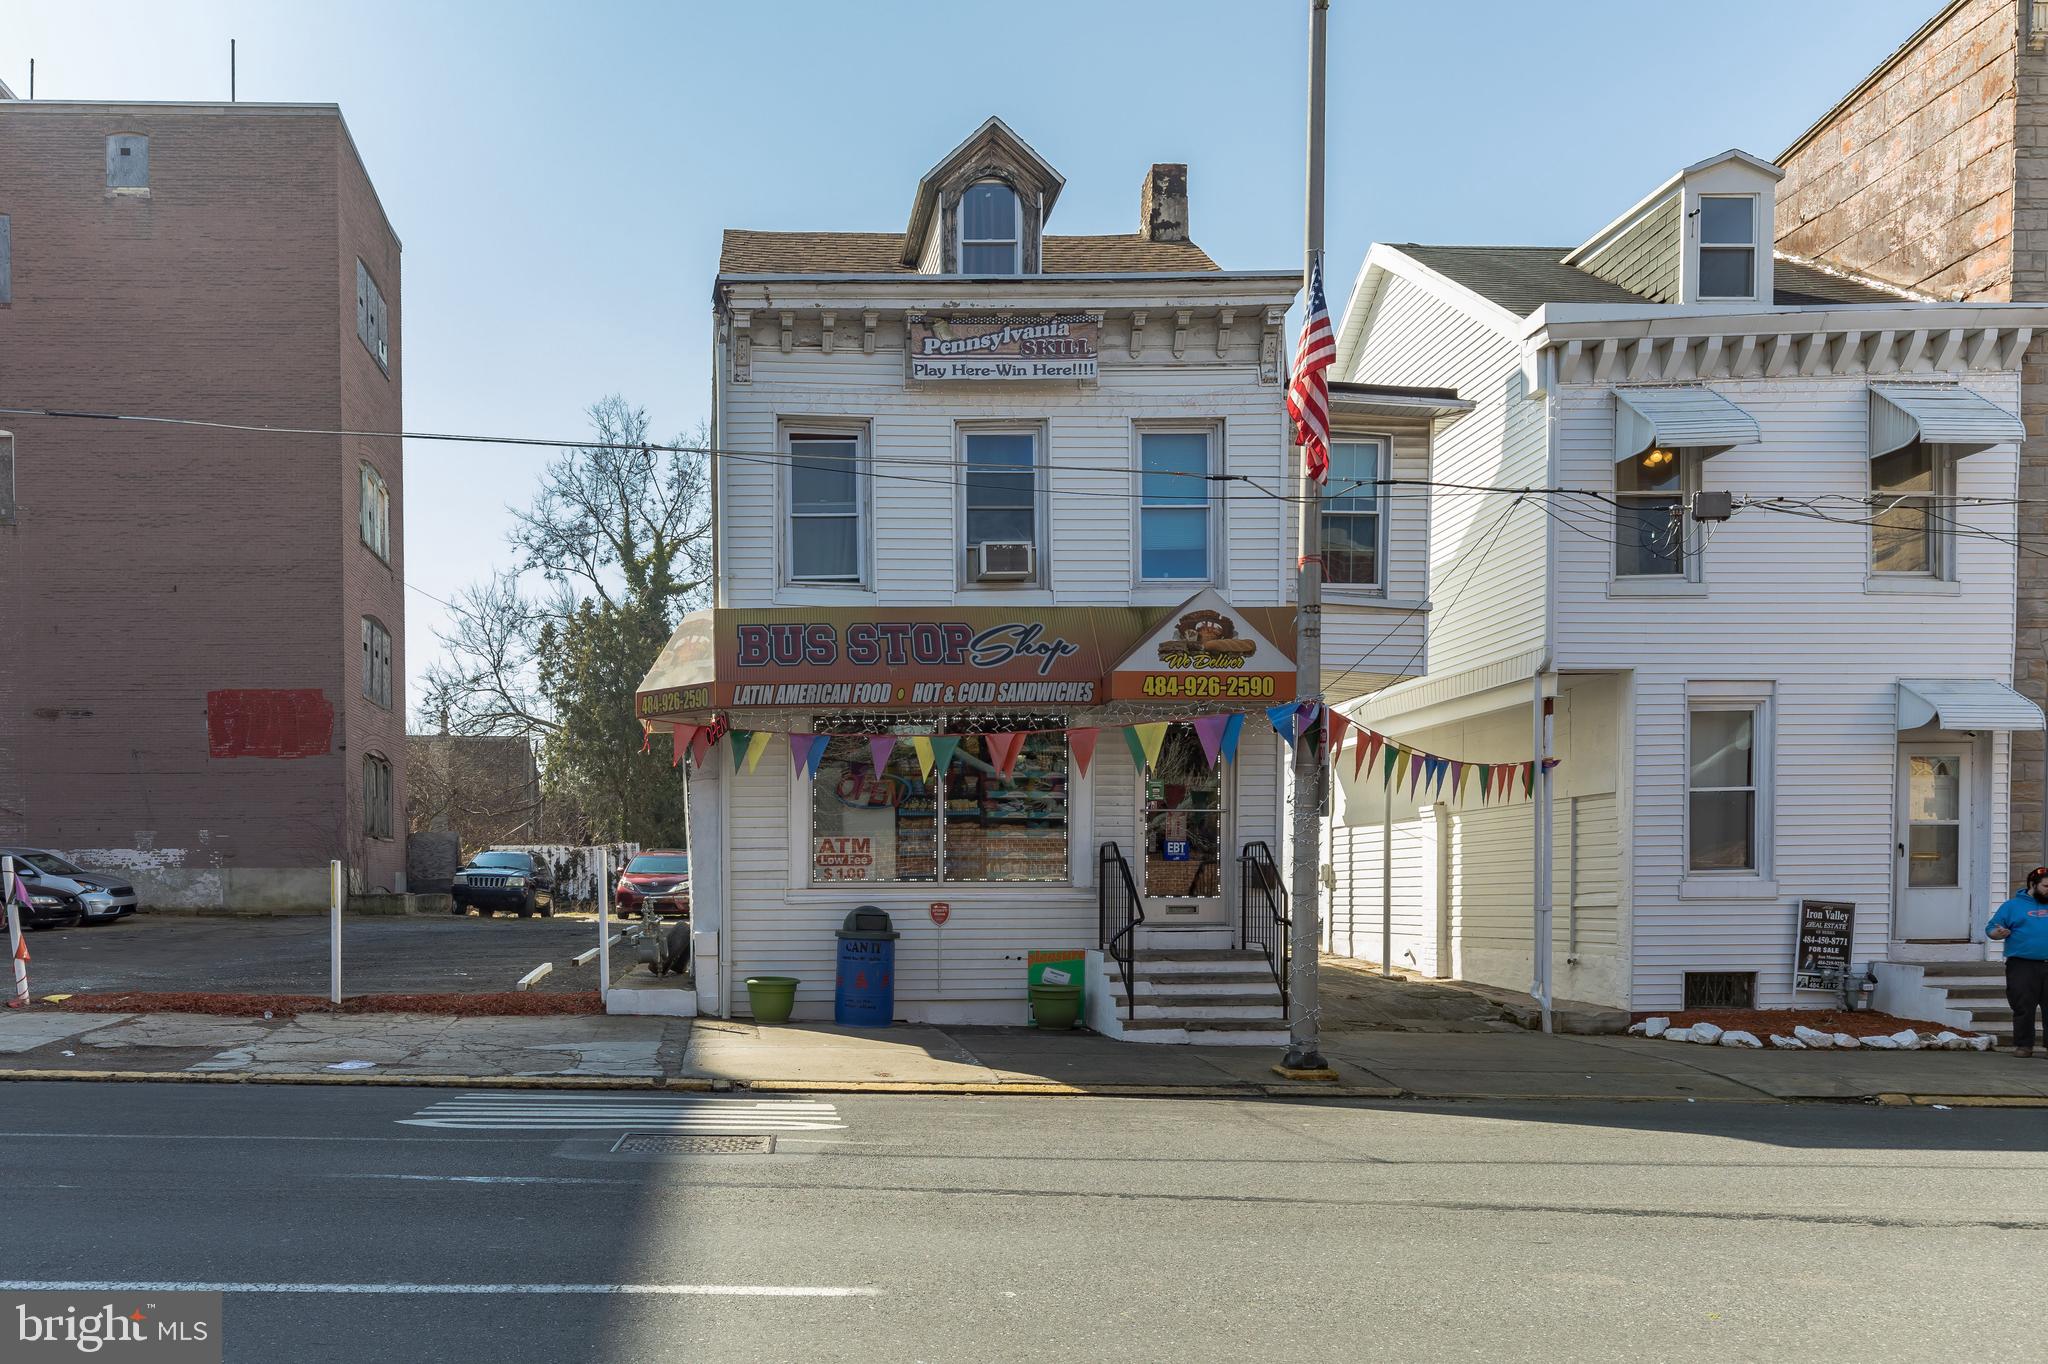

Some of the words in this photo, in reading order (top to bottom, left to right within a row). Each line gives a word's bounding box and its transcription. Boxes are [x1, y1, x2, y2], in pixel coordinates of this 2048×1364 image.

[922, 320, 1071, 356] Pennsylvania
[1020, 337, 1093, 357] SKILL
[914, 363, 947, 378] Play
[952, 362, 1028, 377] Here-Win
[1033, 362, 1095, 377] Here!!!!
[737, 624, 838, 667] BUS
[847, 622, 975, 666] STOP
[968, 622, 1080, 676] Shop
[1165, 652, 1192, 670] We
[1192, 652, 1245, 670] Deliver
[732, 684, 775, 706] LATIN
[774, 683, 853, 706] AMERICAN
[852, 682, 893, 706] FOOD
[911, 682, 944, 704] HOT
[943, 685, 956, 704] &
[957, 681, 997, 704] COLD
[996, 681, 1095, 704] SANDWICHES
[1143, 675, 1274, 697] 484-926-2590
[641, 687, 709, 715] 484-926-2590
[819, 837, 871, 854] ATM
[1167, 841, 1186, 853] EBT
[820, 855, 845, 865] Low
[848, 855, 868, 865] Fee
[1806, 908, 1823, 920] Iron
[1825, 909, 1849, 924] Valley
[1823, 922, 1848, 930] ESTATE
